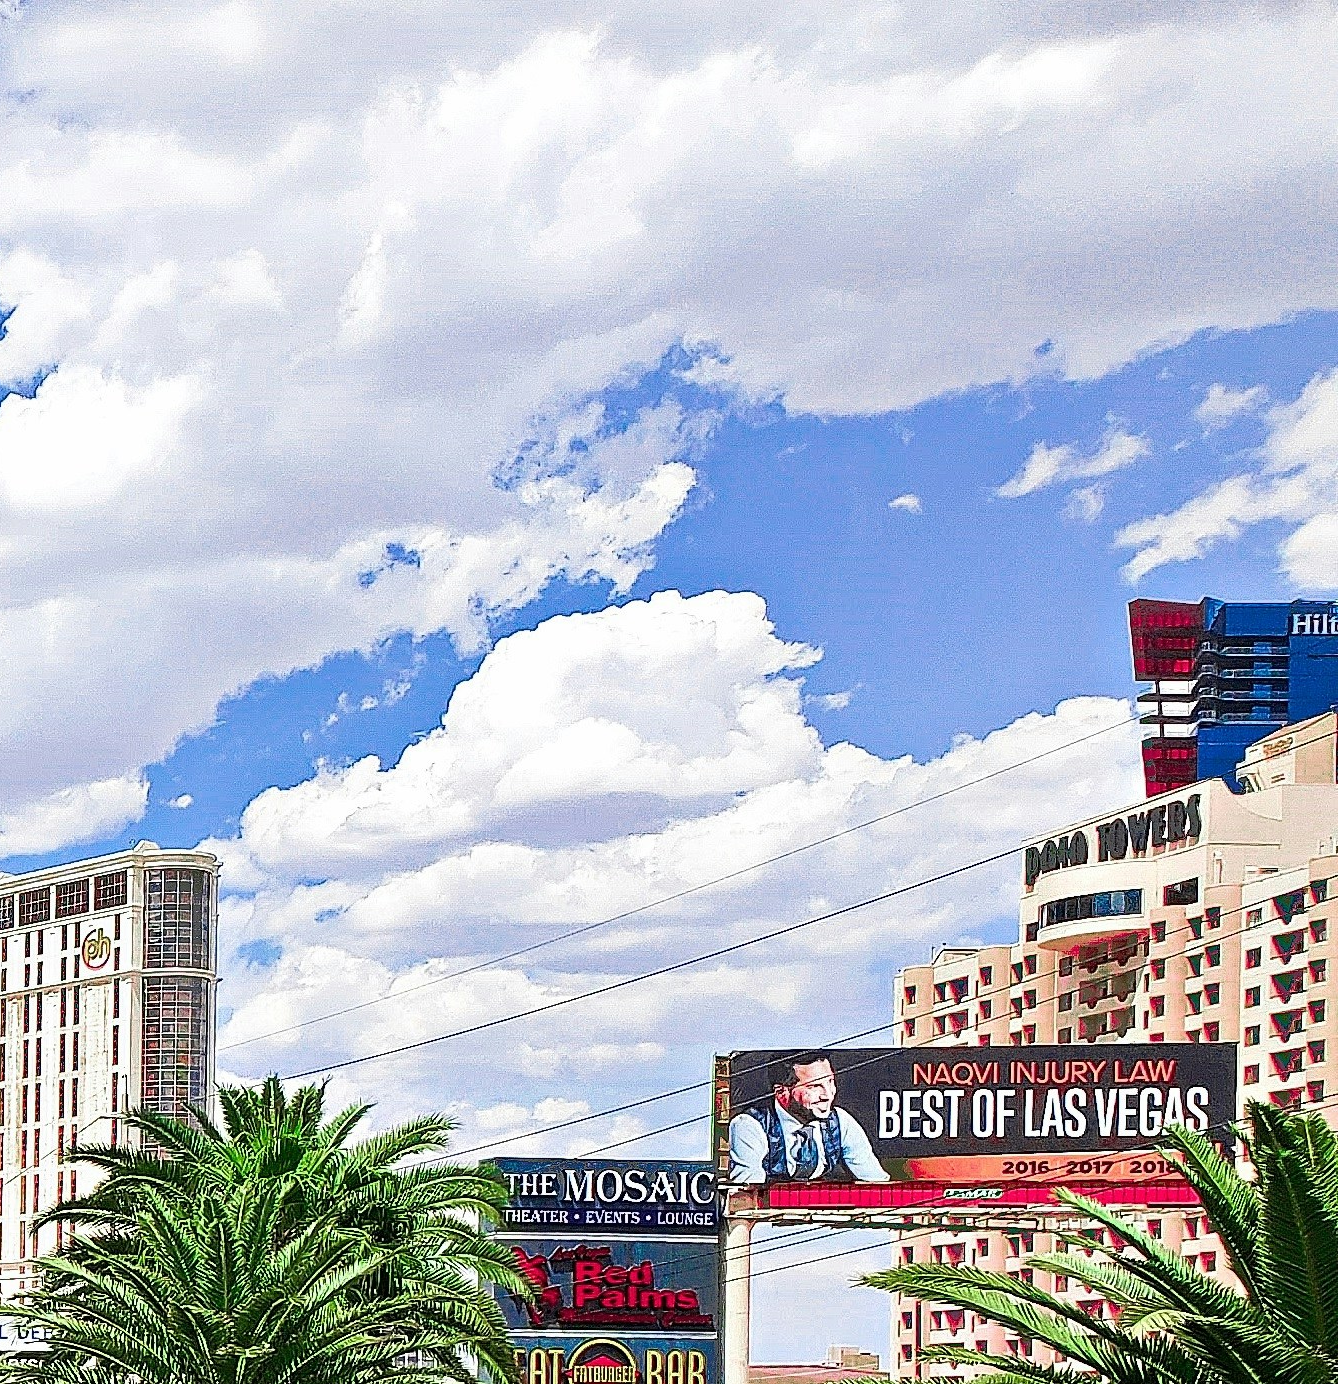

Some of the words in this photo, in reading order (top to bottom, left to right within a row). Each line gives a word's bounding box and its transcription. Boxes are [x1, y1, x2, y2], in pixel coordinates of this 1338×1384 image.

[1096, 794, 1202, 862] TOWERS
[913, 1062, 999, 1086] NAQVI
[1010, 1061, 1107, 1084] INJURY
[1114, 1060, 1176, 1083] LAW
[879, 1089, 964, 1139] BEST
[972, 1088, 1016, 1138] OF
[1025, 1087, 1087, 1138] LAS
[1094, 1086, 1210, 1138] VEGAS
[1002, 1160, 1050, 1175] 2016
[1067, 1160, 1114, 1175] 2017
[503, 1172, 557, 1196] THE
[564, 1169, 716, 1204] MOSAIC
[504, 1209, 569, 1224] THEATER
[585, 1211, 641, 1224] EVENTS
[657, 1212, 714, 1226] LOUNGE
[574, 1260, 654, 1287] Red
[574, 1284, 700, 1311] Palms
[573, 1365, 636, 1383] FATBURGER
